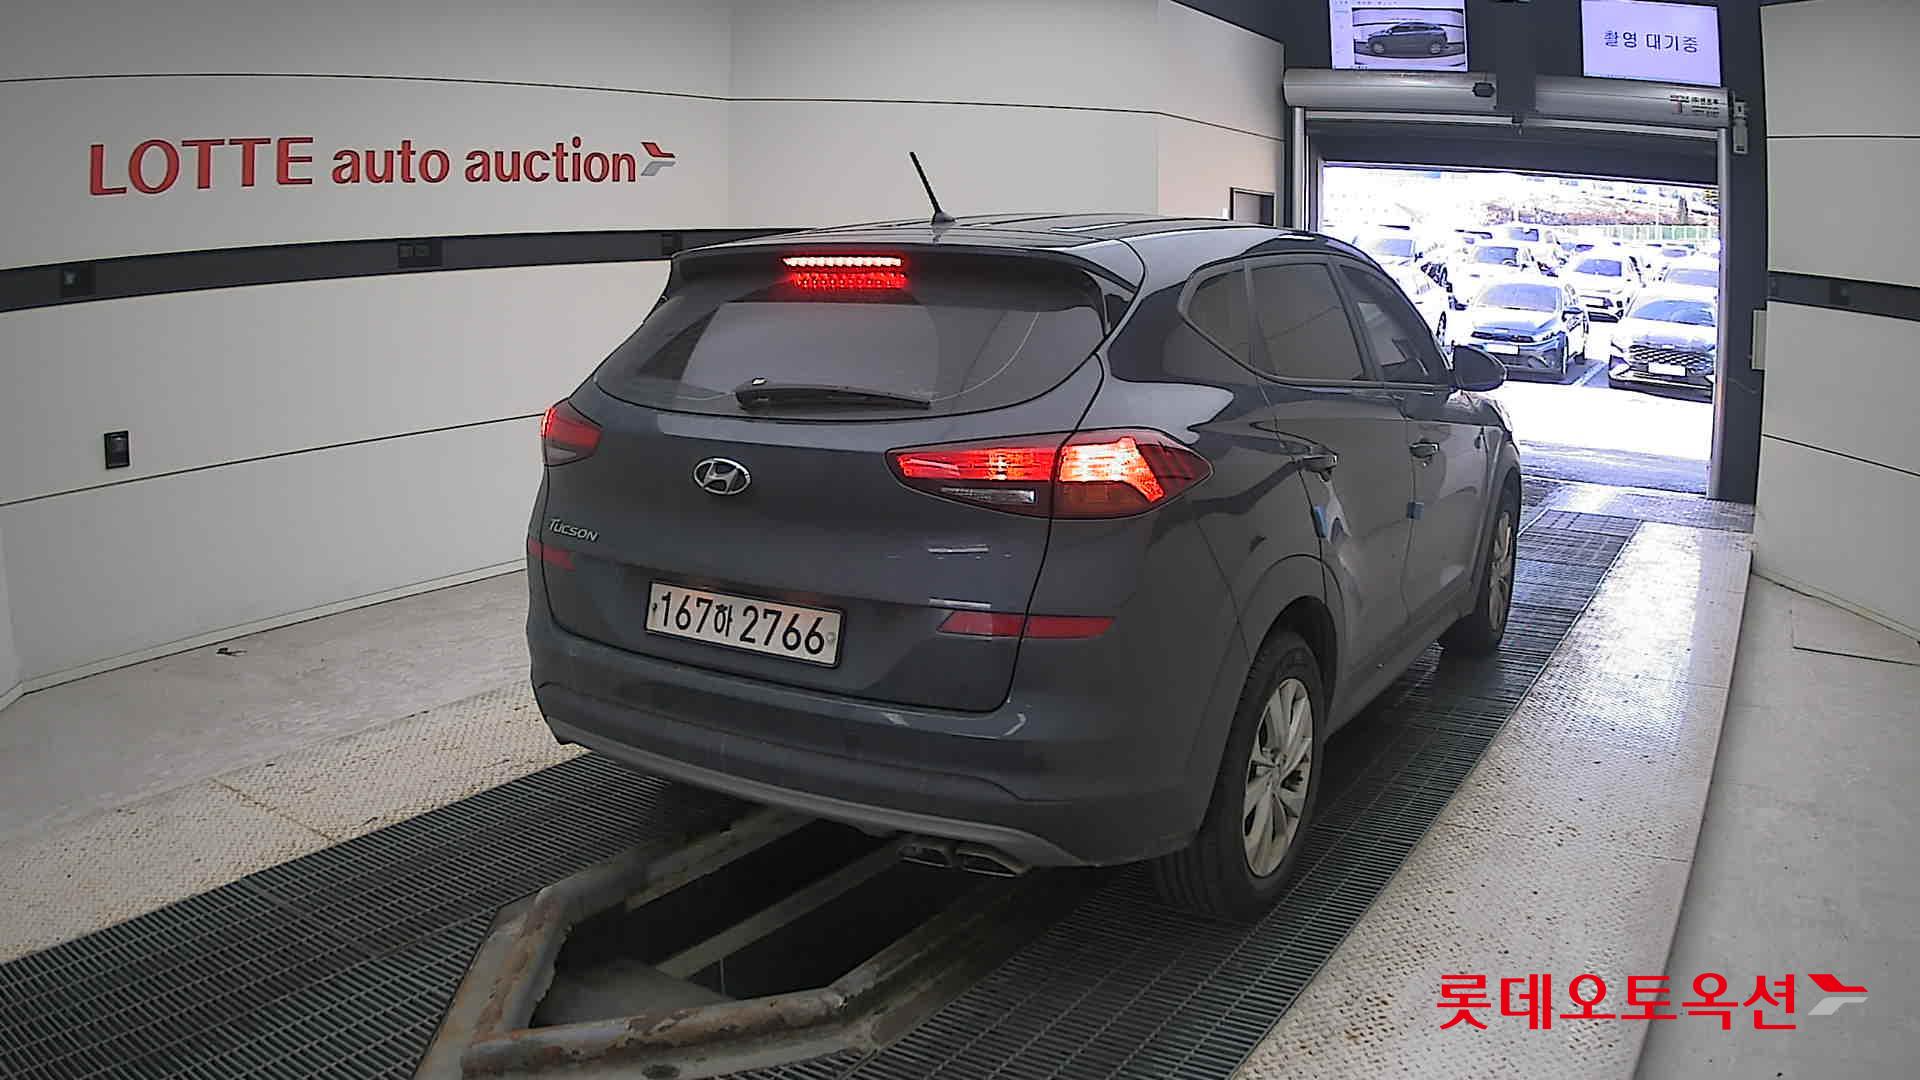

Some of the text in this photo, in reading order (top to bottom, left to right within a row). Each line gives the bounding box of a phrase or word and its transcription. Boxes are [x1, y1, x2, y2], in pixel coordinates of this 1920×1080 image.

[1604, 30, 1698, 53] 촬영 대기중
[90, 136, 637, 195] LOTTE auto auction
[549, 518, 599, 541] TUCSON
[661, 591, 825, 655] 167하 2766
